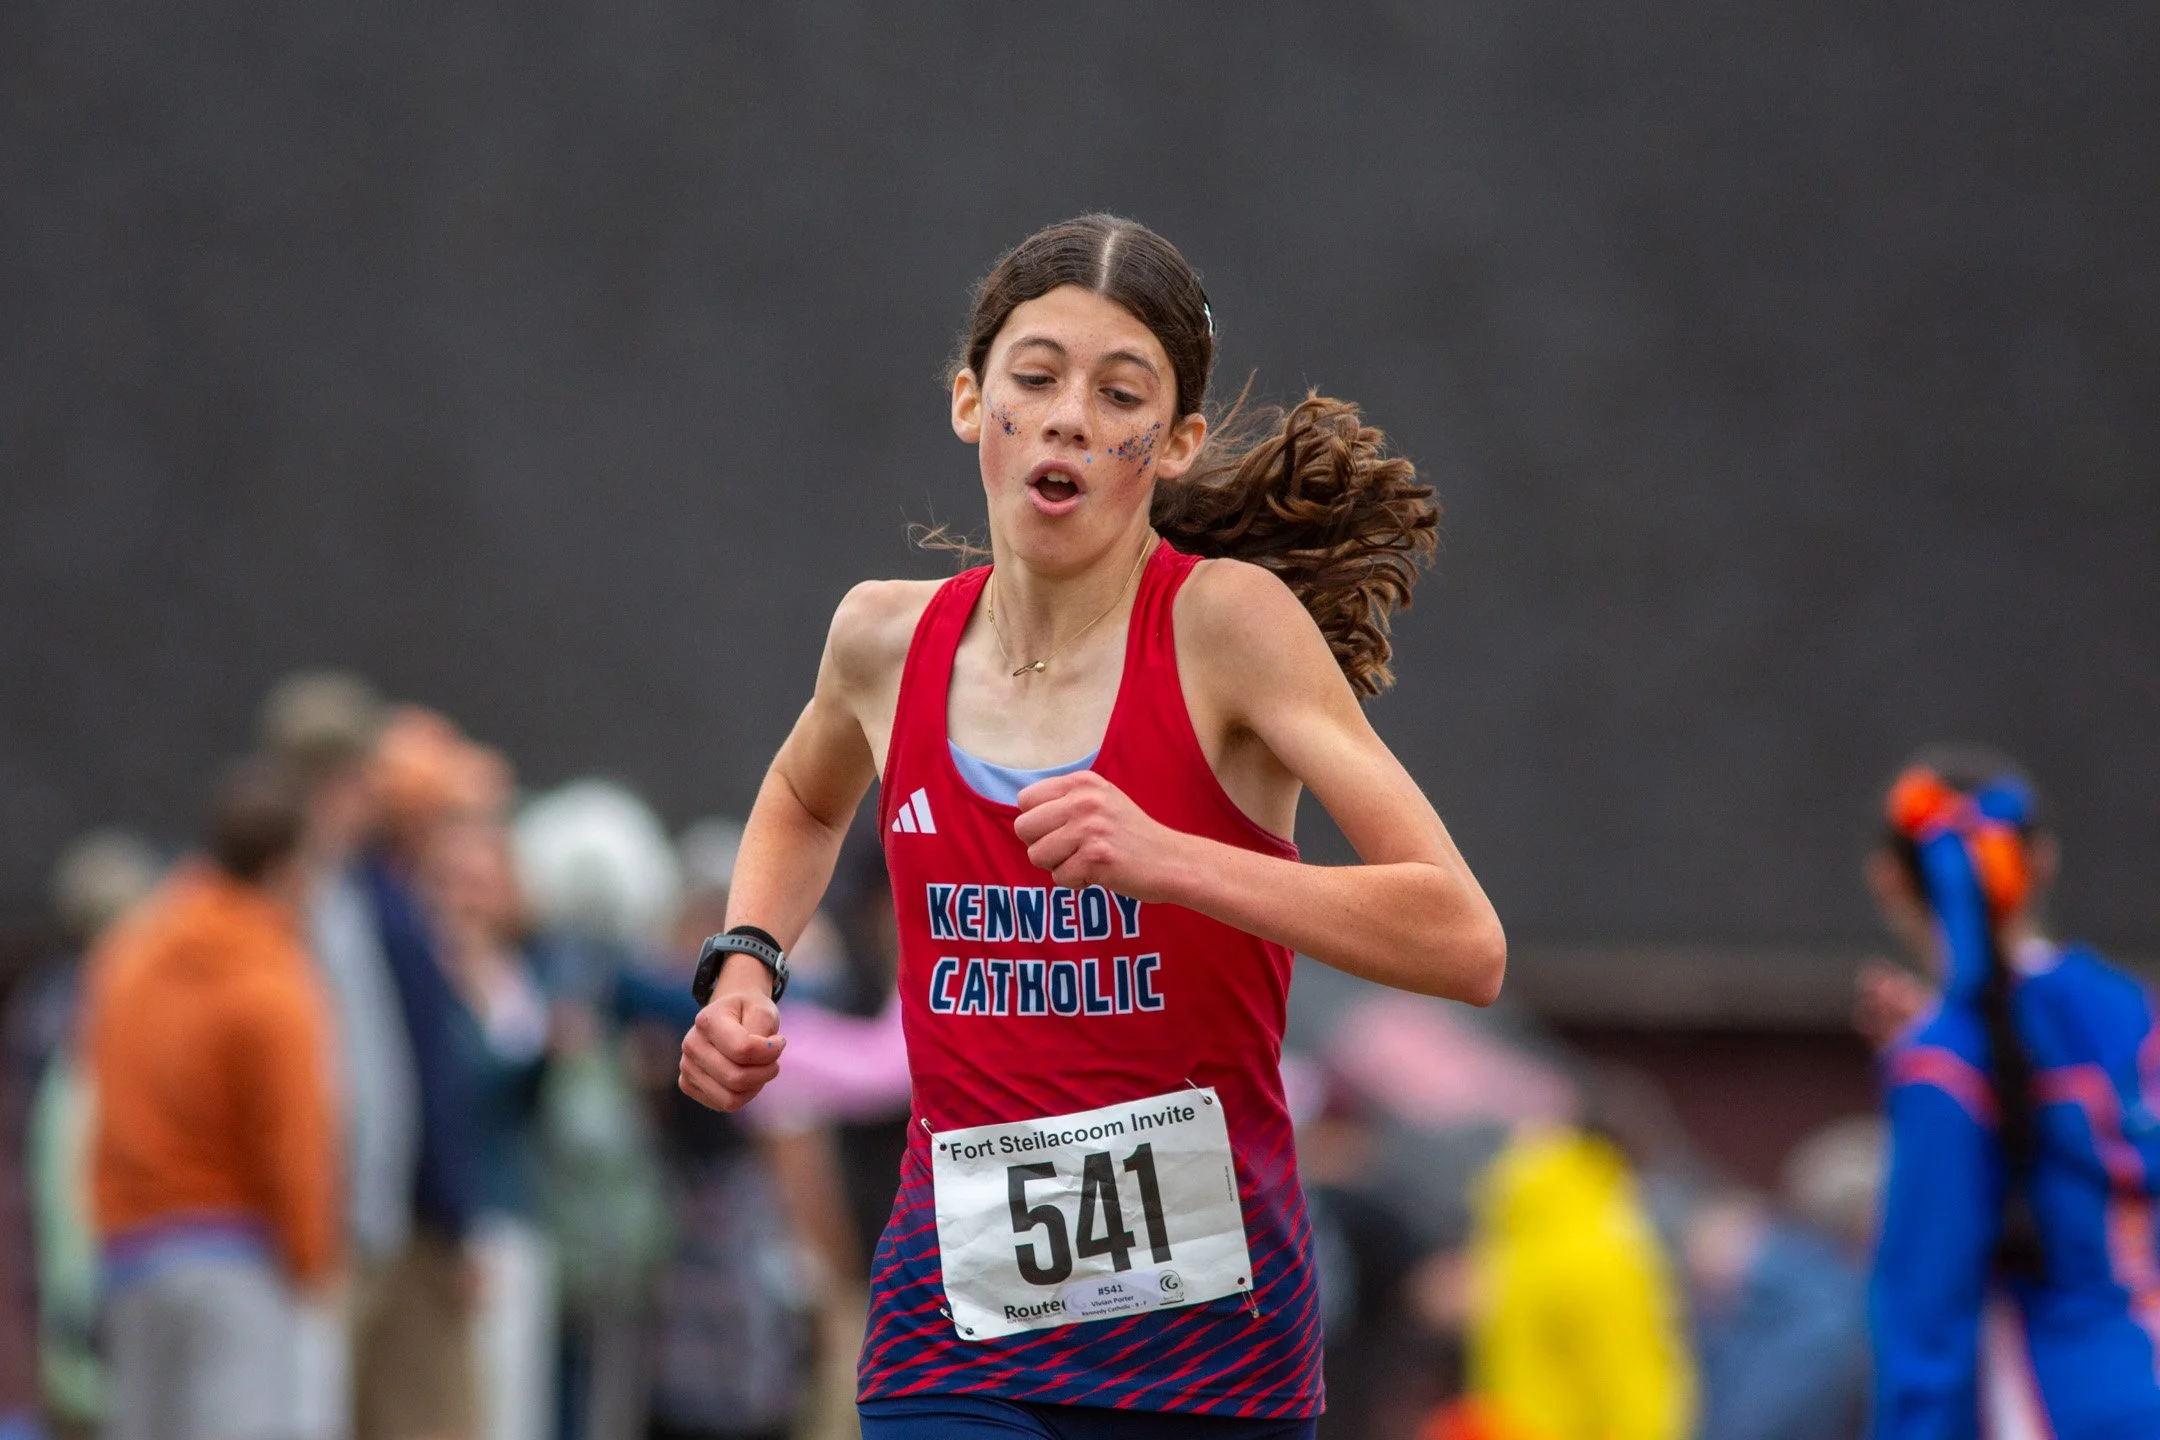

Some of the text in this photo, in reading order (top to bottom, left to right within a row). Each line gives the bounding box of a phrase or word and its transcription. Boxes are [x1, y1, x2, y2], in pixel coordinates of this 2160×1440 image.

[926, 882, 1141, 943] KENNEDY
[929, 952, 1165, 1017] CATHOLIC
[951, 1106, 1196, 1161] Fort Steilacoom Invite
[1007, 1142, 1172, 1286] 541
[1091, 1295, 1134, 1307] Vivian Porter
[1098, 1284, 1124, 1296] #541
